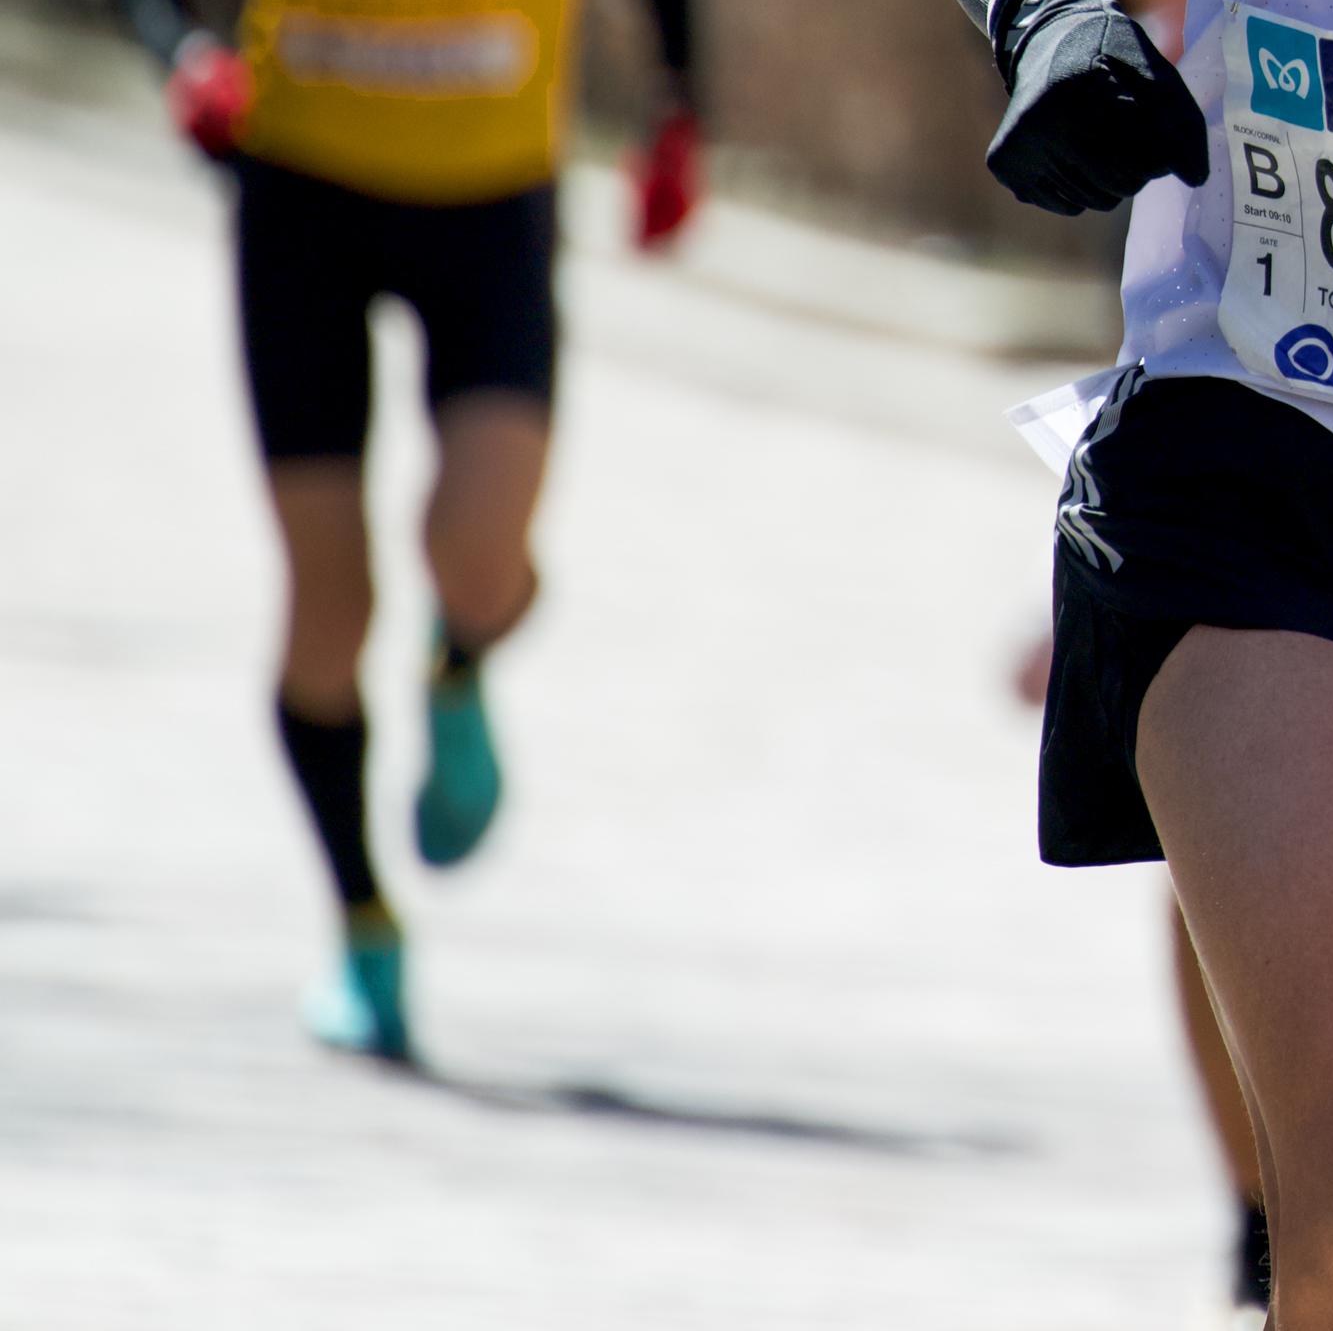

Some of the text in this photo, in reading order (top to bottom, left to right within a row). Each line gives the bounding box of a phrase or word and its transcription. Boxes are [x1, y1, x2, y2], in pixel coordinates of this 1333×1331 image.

[1243, 142, 1286, 200] B
[1244, 203, 1292, 225] Start 09:10
[1259, 236, 1279, 248] GATE
[1256, 252, 1273, 297] 1
